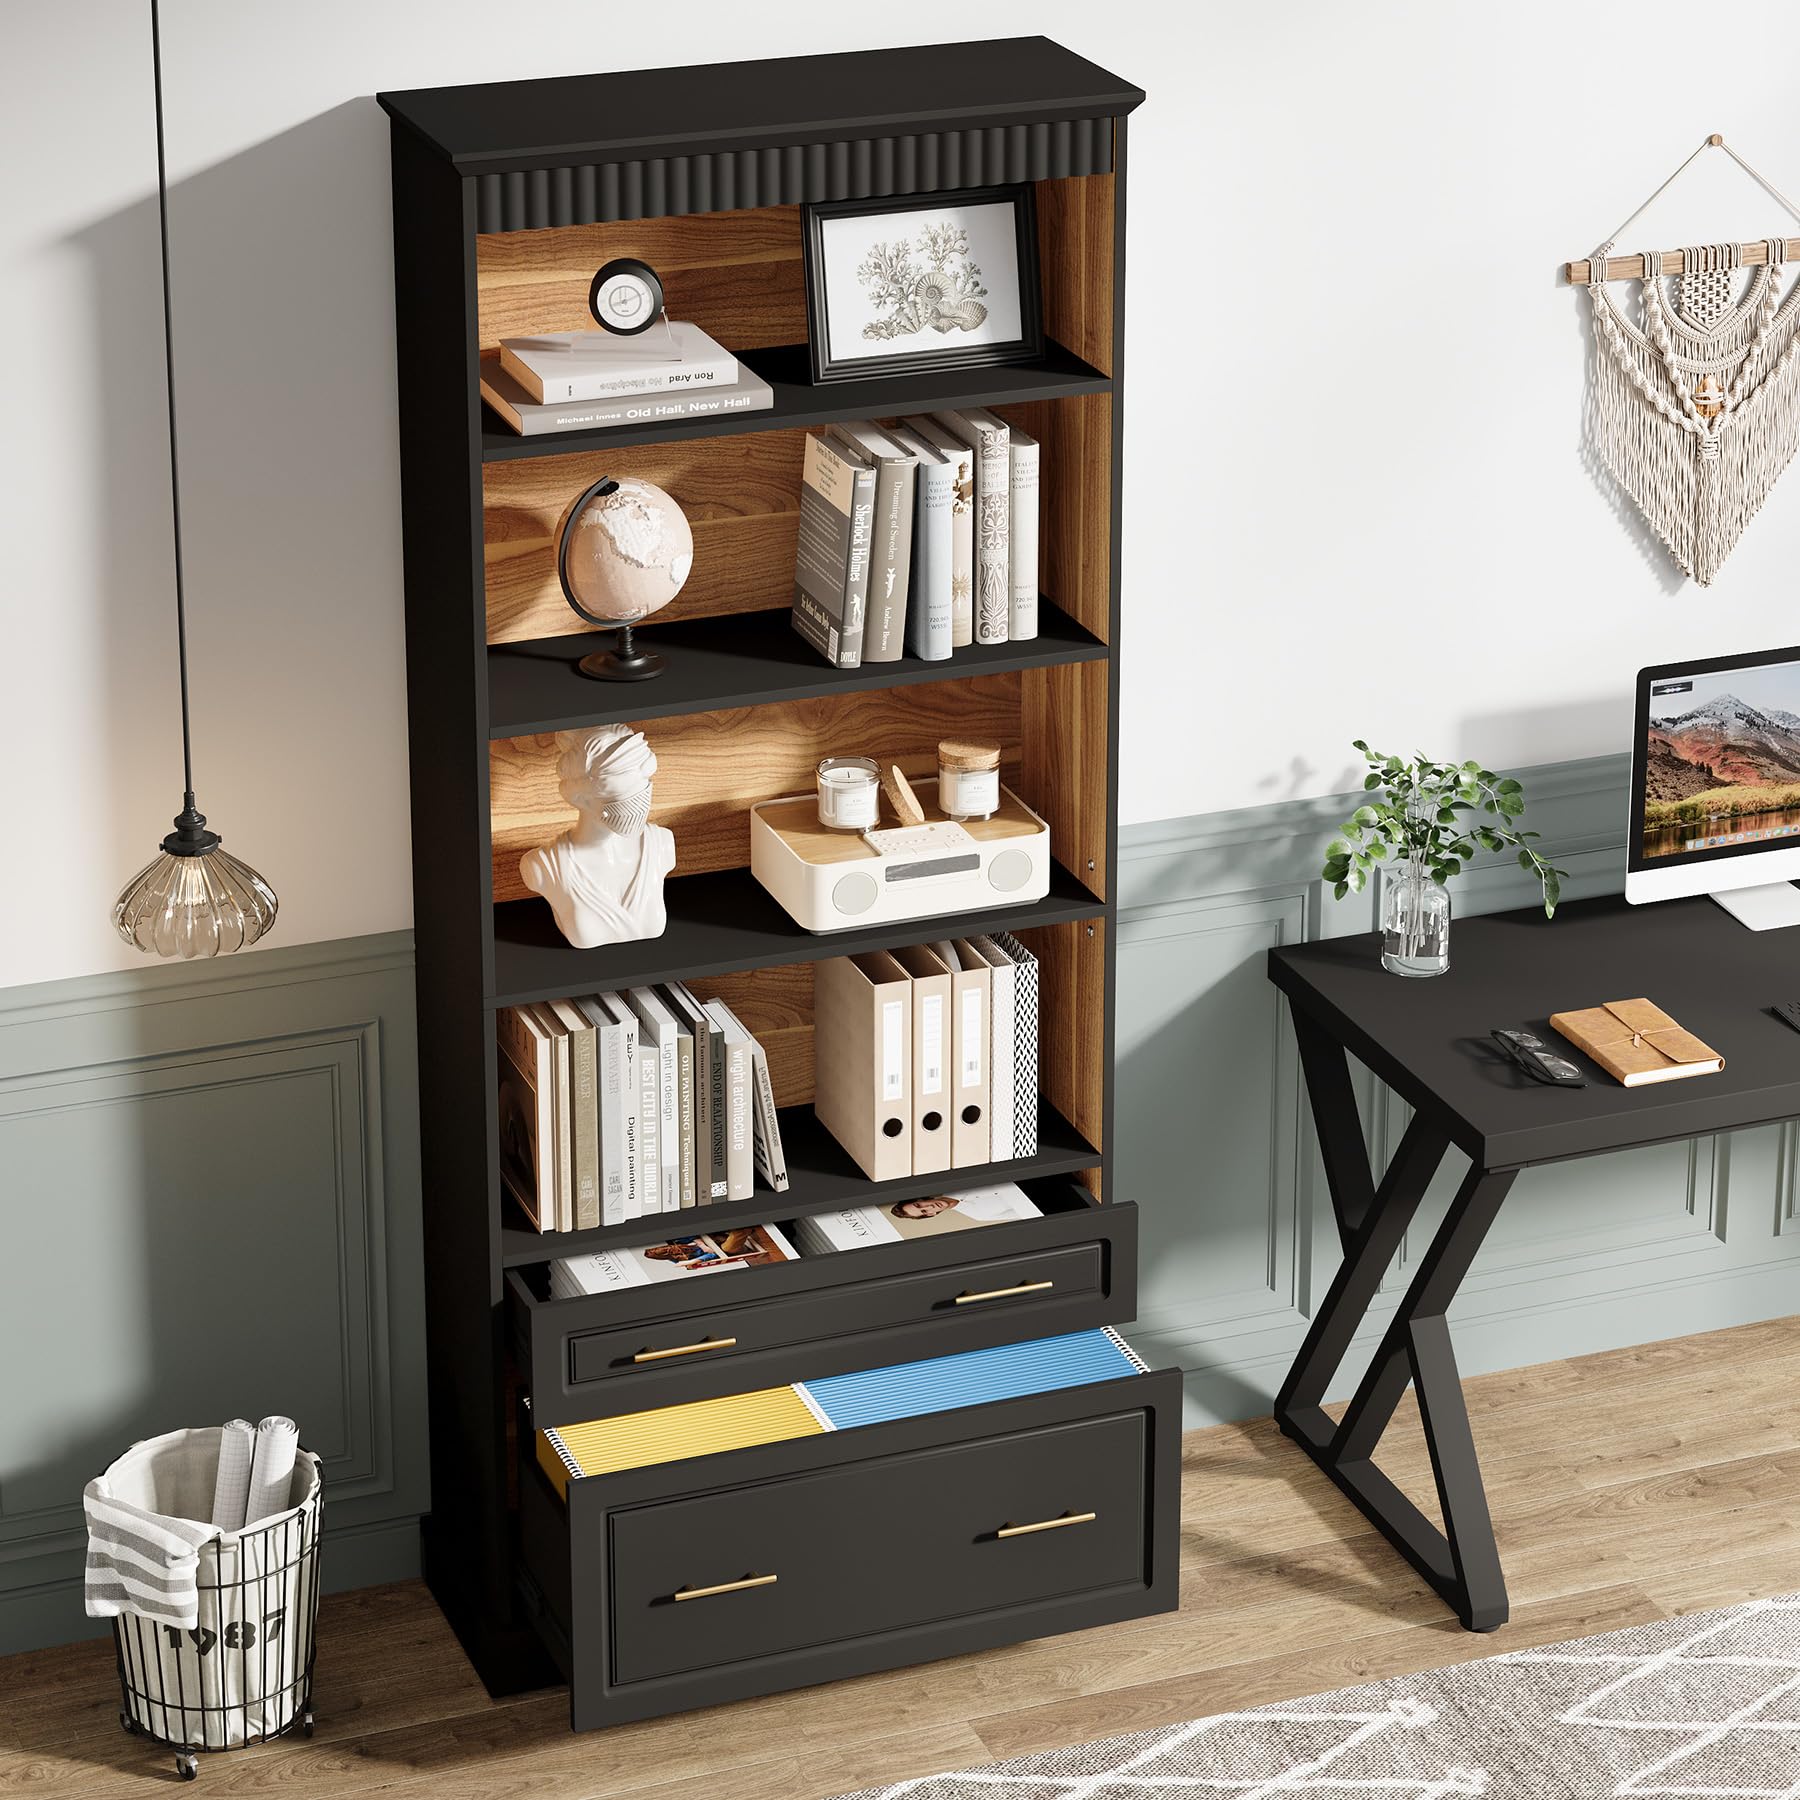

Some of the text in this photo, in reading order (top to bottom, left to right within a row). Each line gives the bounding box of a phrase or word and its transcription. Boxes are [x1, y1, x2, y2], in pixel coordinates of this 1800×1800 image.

[669, 371, 714, 384] Ron Arad
[556, 412, 622, 425] Michael Innes
[626, 396, 751, 419] Old Hall, New Hall
[854, 504, 872, 545] Sherlock
[887, 480, 904, 561] Dreaming of Sweden
[849, 546, 867, 582] Holmes
[642, 1060, 656, 1088] BEST
[662, 1042, 674, 1121] Light in design
[713, 1062, 722, 1081] END
[643, 1091, 656, 1118] CITY
[682, 1077, 690, 1130] PAINTING
[713, 1082, 722, 1096] OF
[730, 1049, 747, 1151] wright architecture
[627, 1116, 636, 1200] Digital painting
[643, 1137, 657, 1160] THE
[682, 1134, 691, 1187] Techniques
[644, 1163, 657, 1204] WORLD
[840, 1210, 869, 1237] KINFO
